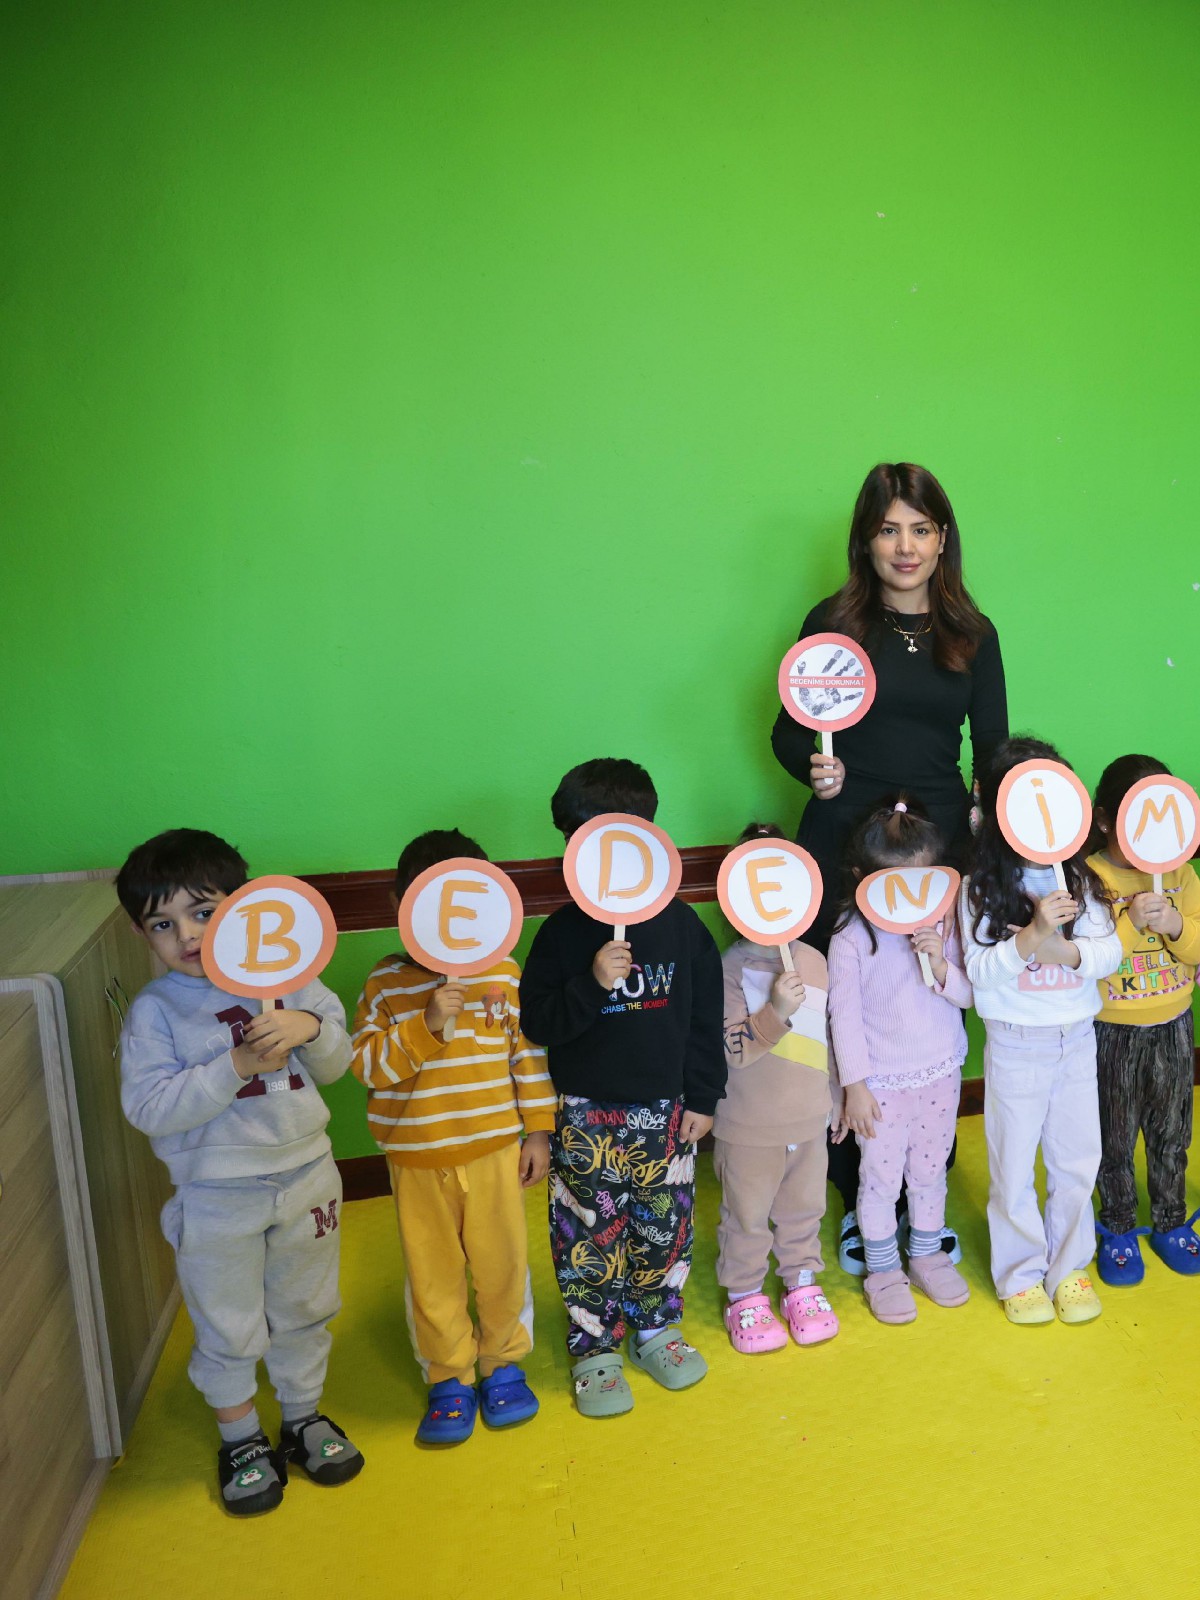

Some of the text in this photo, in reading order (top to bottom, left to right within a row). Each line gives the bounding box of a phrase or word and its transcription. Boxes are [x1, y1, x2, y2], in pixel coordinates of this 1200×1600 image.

[1132, 793, 1186, 851] M
[597, 830, 655, 902] D
[745, 856, 793, 922] E
[437, 879, 492, 950] E
[883, 871, 933, 916] N
[235, 899, 301, 974] B
[1117, 951, 1178, 976] HELL
[1121, 965, 1180, 993] KITTY
[601, 1004, 627, 1015] CHASE
[626, 1001, 643, 1012] THE
[267, 1079, 289, 1093] 1991
